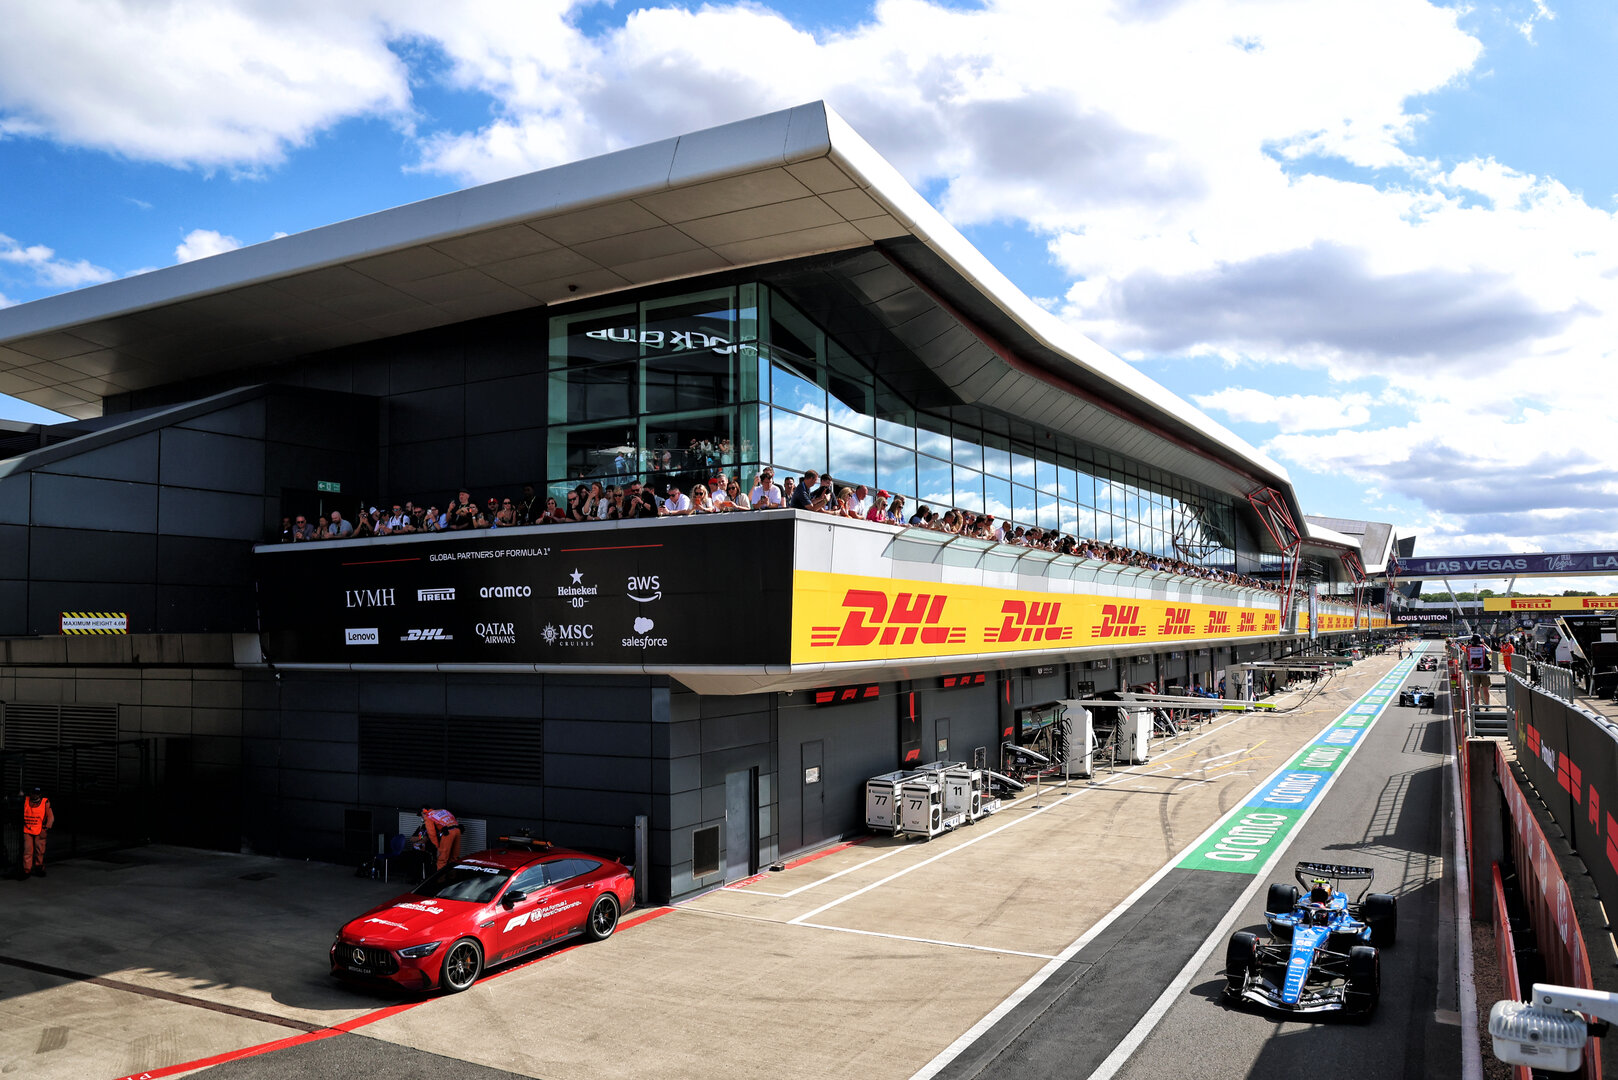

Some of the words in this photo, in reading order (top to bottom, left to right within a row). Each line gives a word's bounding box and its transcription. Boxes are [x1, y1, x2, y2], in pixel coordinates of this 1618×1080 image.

[429, 553, 456, 562] GLOBAL
[457, 550, 494, 560] PARTNERS
[495, 549, 505, 558] OF
[506, 548, 542, 558] FORMULA
[1425, 559, 1460, 573] LAS
[1461, 558, 1528, 571] VEGAS
[558, 585, 598, 596] Heineken
[627, 575, 660, 591] aws
[345, 588, 396, 608] LVMH
[417, 587, 456, 602] PIRELLI
[479, 585, 532, 598] aramco
[1510, 599, 1551, 609] PIRELLI
[836, 589, 953, 647] DHL
[999, 600, 1063, 642] DHL
[1099, 605, 1140, 638] DHL
[1163, 608, 1191, 635] DHL
[1208, 610, 1228, 634] DHL
[1239, 612, 1255, 632] DHL
[1263, 613, 1276, 631] DHL
[348, 632, 376, 641] Lenovo
[406, 628, 446, 641] DHL
[475, 622, 515, 637] QATAR
[559, 624, 594, 639] MSC
[484, 635, 516, 644] AIRWAYS
[621, 635, 668, 650] salesforce
[953, 786, 962, 796] 11
[1263, 773, 1322, 804] aramco
[874, 795, 888, 806] 77
[909, 799, 923, 810] 77
[1204, 813, 1289, 862] aramco
[503, 911, 532, 934] F1
